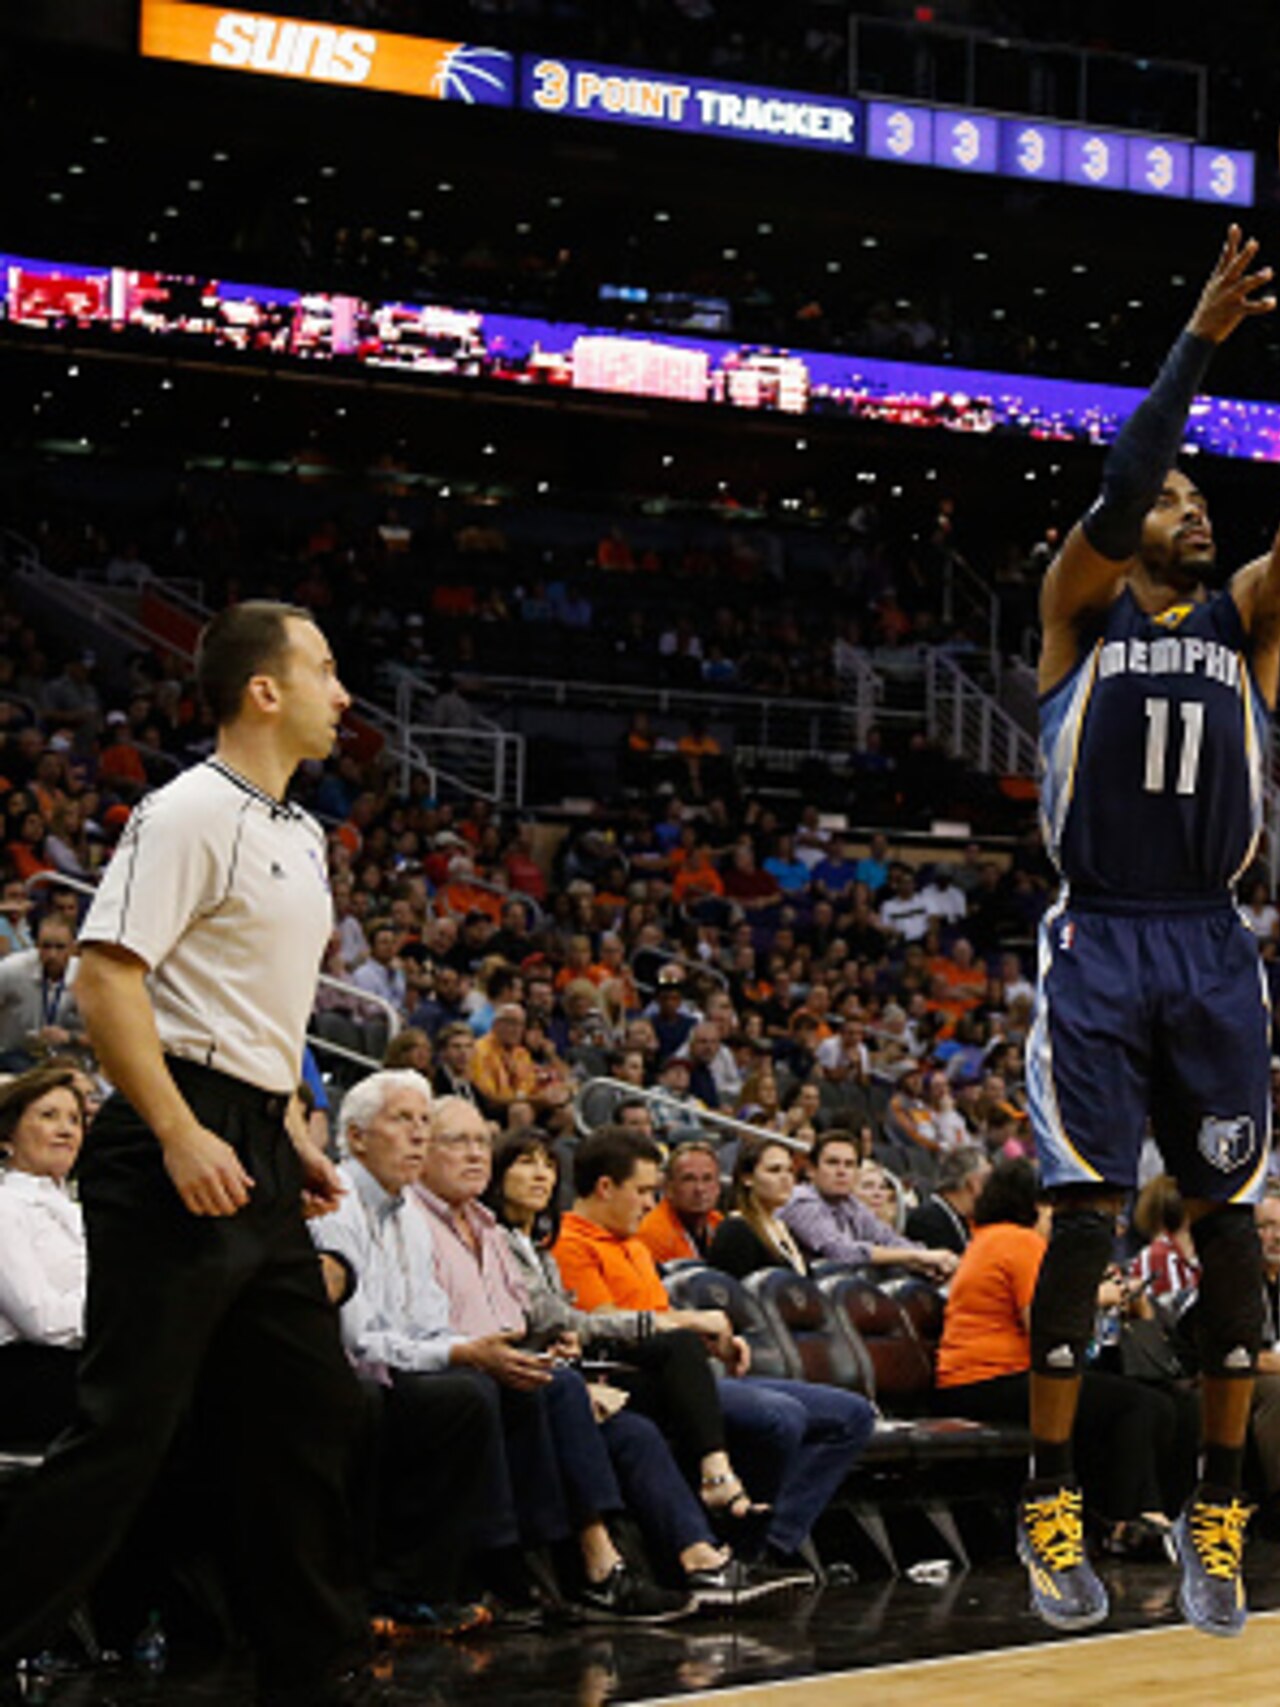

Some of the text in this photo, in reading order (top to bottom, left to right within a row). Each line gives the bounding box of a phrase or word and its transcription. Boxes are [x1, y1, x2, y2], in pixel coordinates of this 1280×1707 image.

[210, 12, 378, 83] SUNS
[533, 60, 854, 142] 3 POINT TRACKER
[886, 111, 1236, 198] 3 3 3 3 3 3
[1099, 637, 1241, 697] MEMPHI
[1143, 698, 1204, 794] 11
